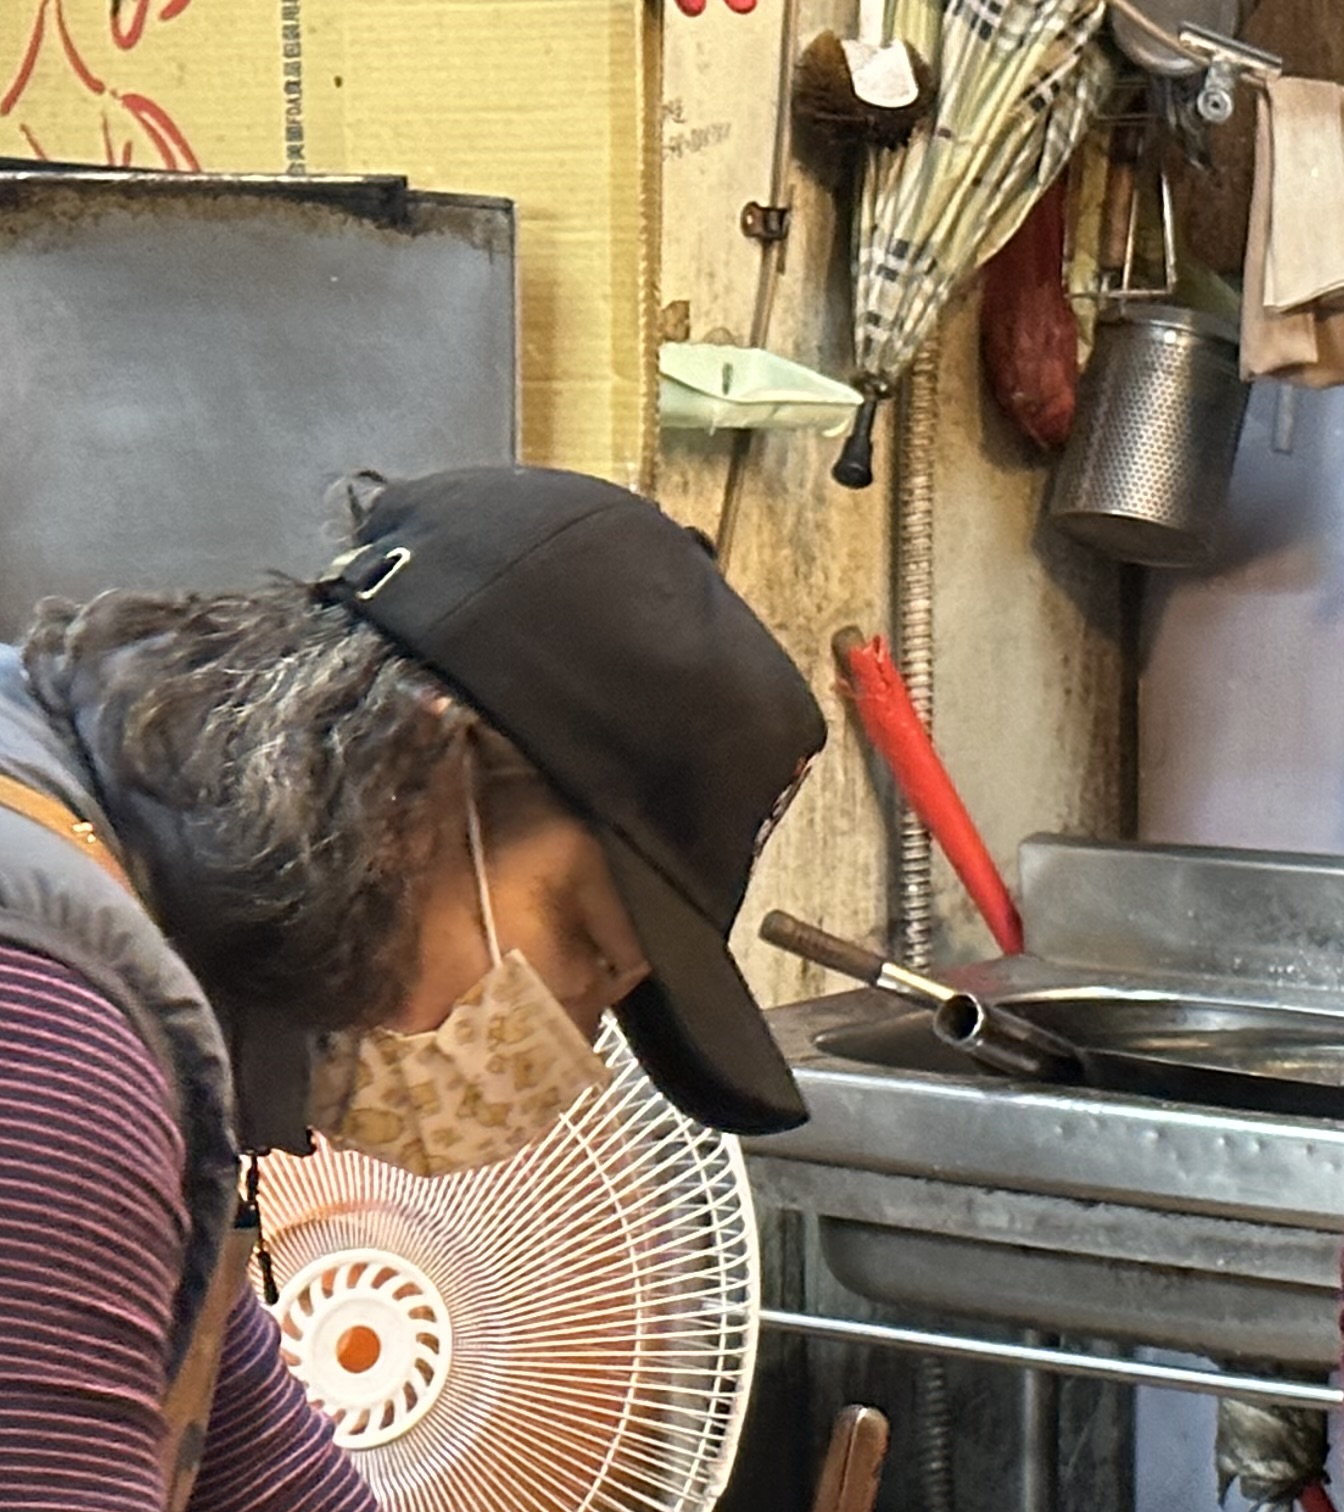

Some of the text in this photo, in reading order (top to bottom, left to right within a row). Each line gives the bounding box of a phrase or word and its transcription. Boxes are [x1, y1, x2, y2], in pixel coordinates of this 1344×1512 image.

[282, 0, 305, 176] 合美國FDA食品包裝用
